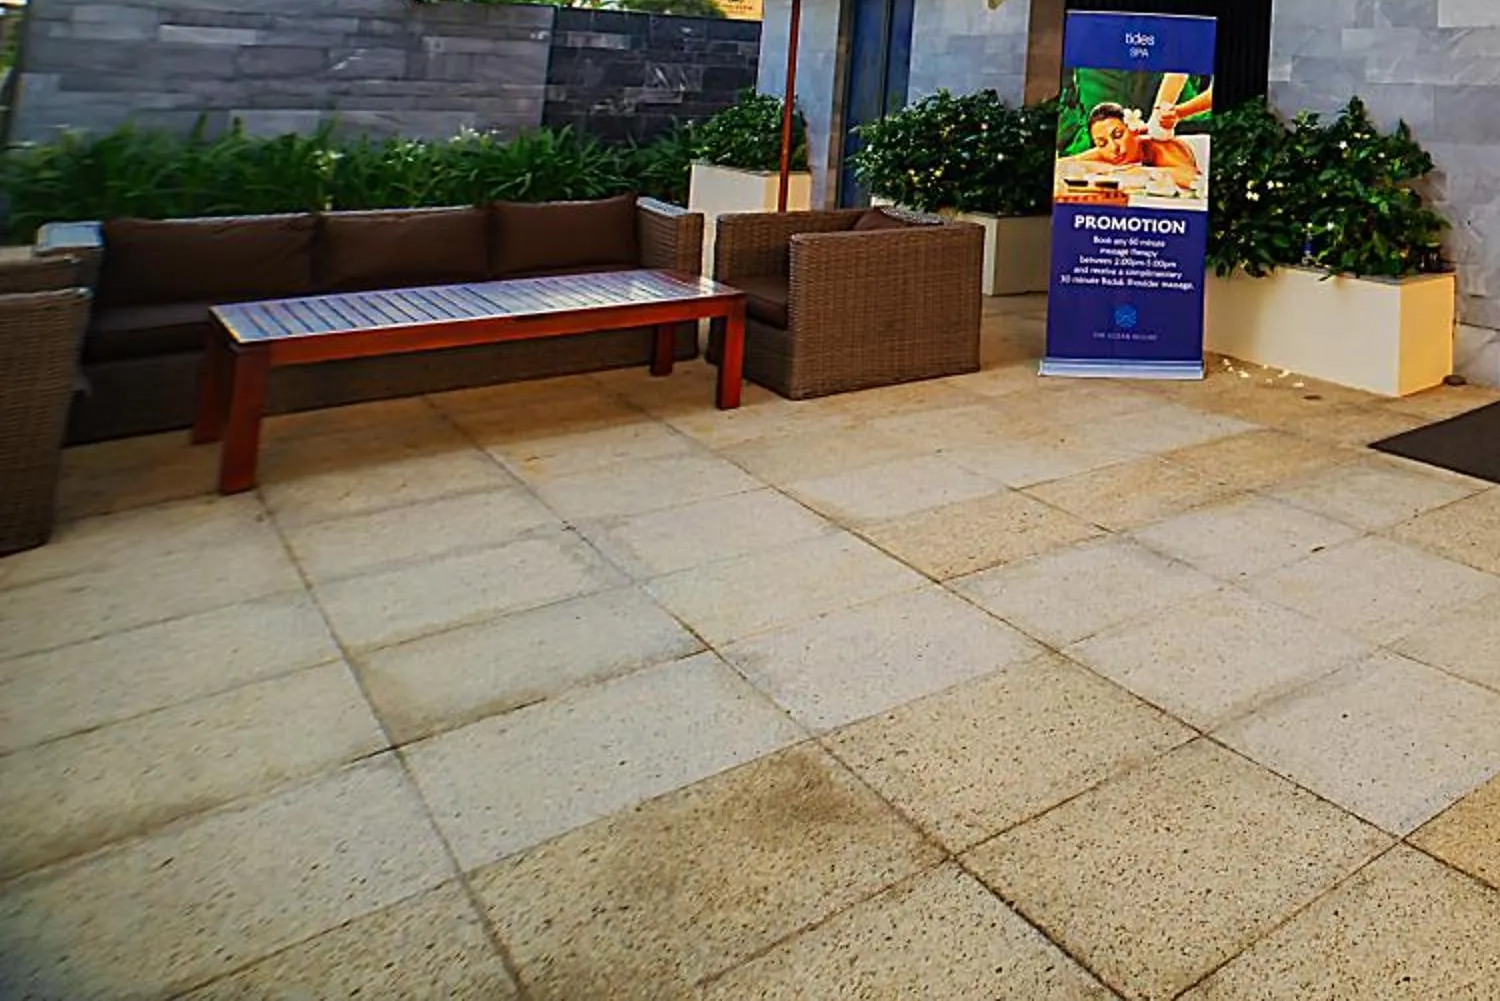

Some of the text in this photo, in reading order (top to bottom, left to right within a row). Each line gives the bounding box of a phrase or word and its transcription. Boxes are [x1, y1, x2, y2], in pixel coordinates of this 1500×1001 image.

[1125, 32, 1155, 46] tides
[1129, 47, 1149, 57] SPA
[1074, 215, 1186, 234] PROMOTION
